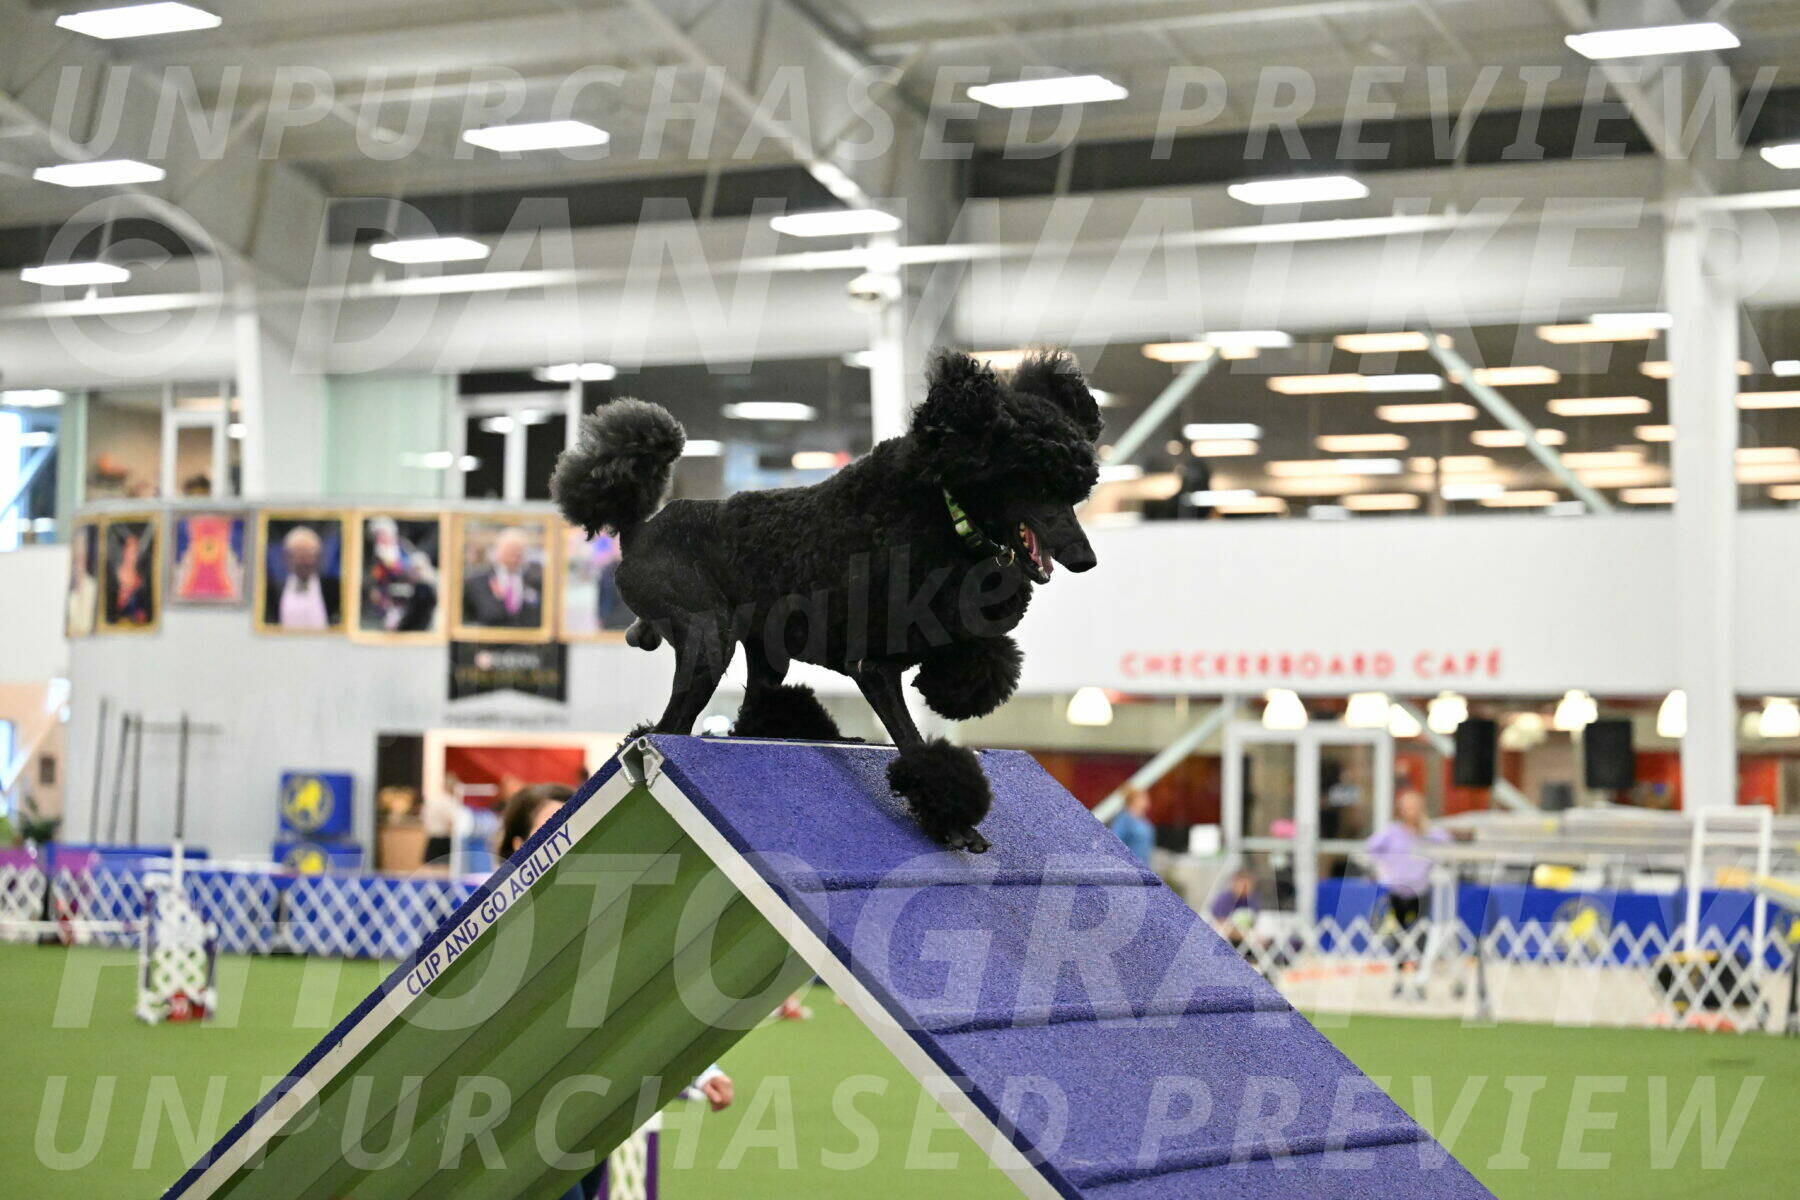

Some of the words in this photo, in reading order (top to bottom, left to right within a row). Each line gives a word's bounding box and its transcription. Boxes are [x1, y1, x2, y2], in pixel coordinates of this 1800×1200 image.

[1119, 652, 1396, 678] CHECKERBOARD
[1413, 645, 1501, 678] CAFÉ
[406, 952, 441, 995] CLIP
[445, 919, 479, 963] AND
[480, 891, 507, 924] GO
[509, 823, 573, 900] AGILITY
